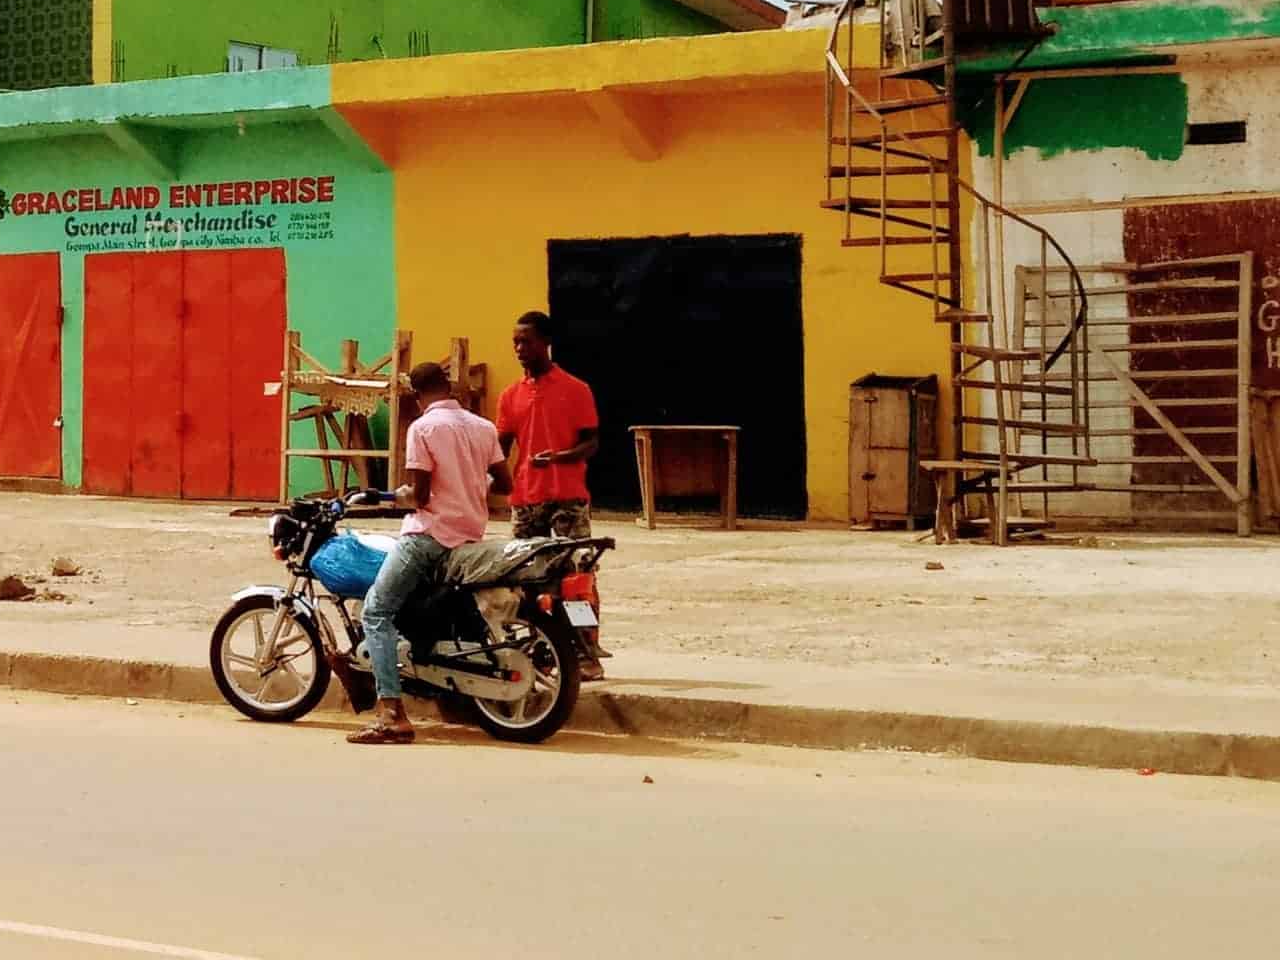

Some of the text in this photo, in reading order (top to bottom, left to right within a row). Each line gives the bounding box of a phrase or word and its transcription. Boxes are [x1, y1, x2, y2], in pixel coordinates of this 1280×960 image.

[10, 176, 336, 216] GRACELAND ENTERPRISE
[64, 214, 138, 237] General
